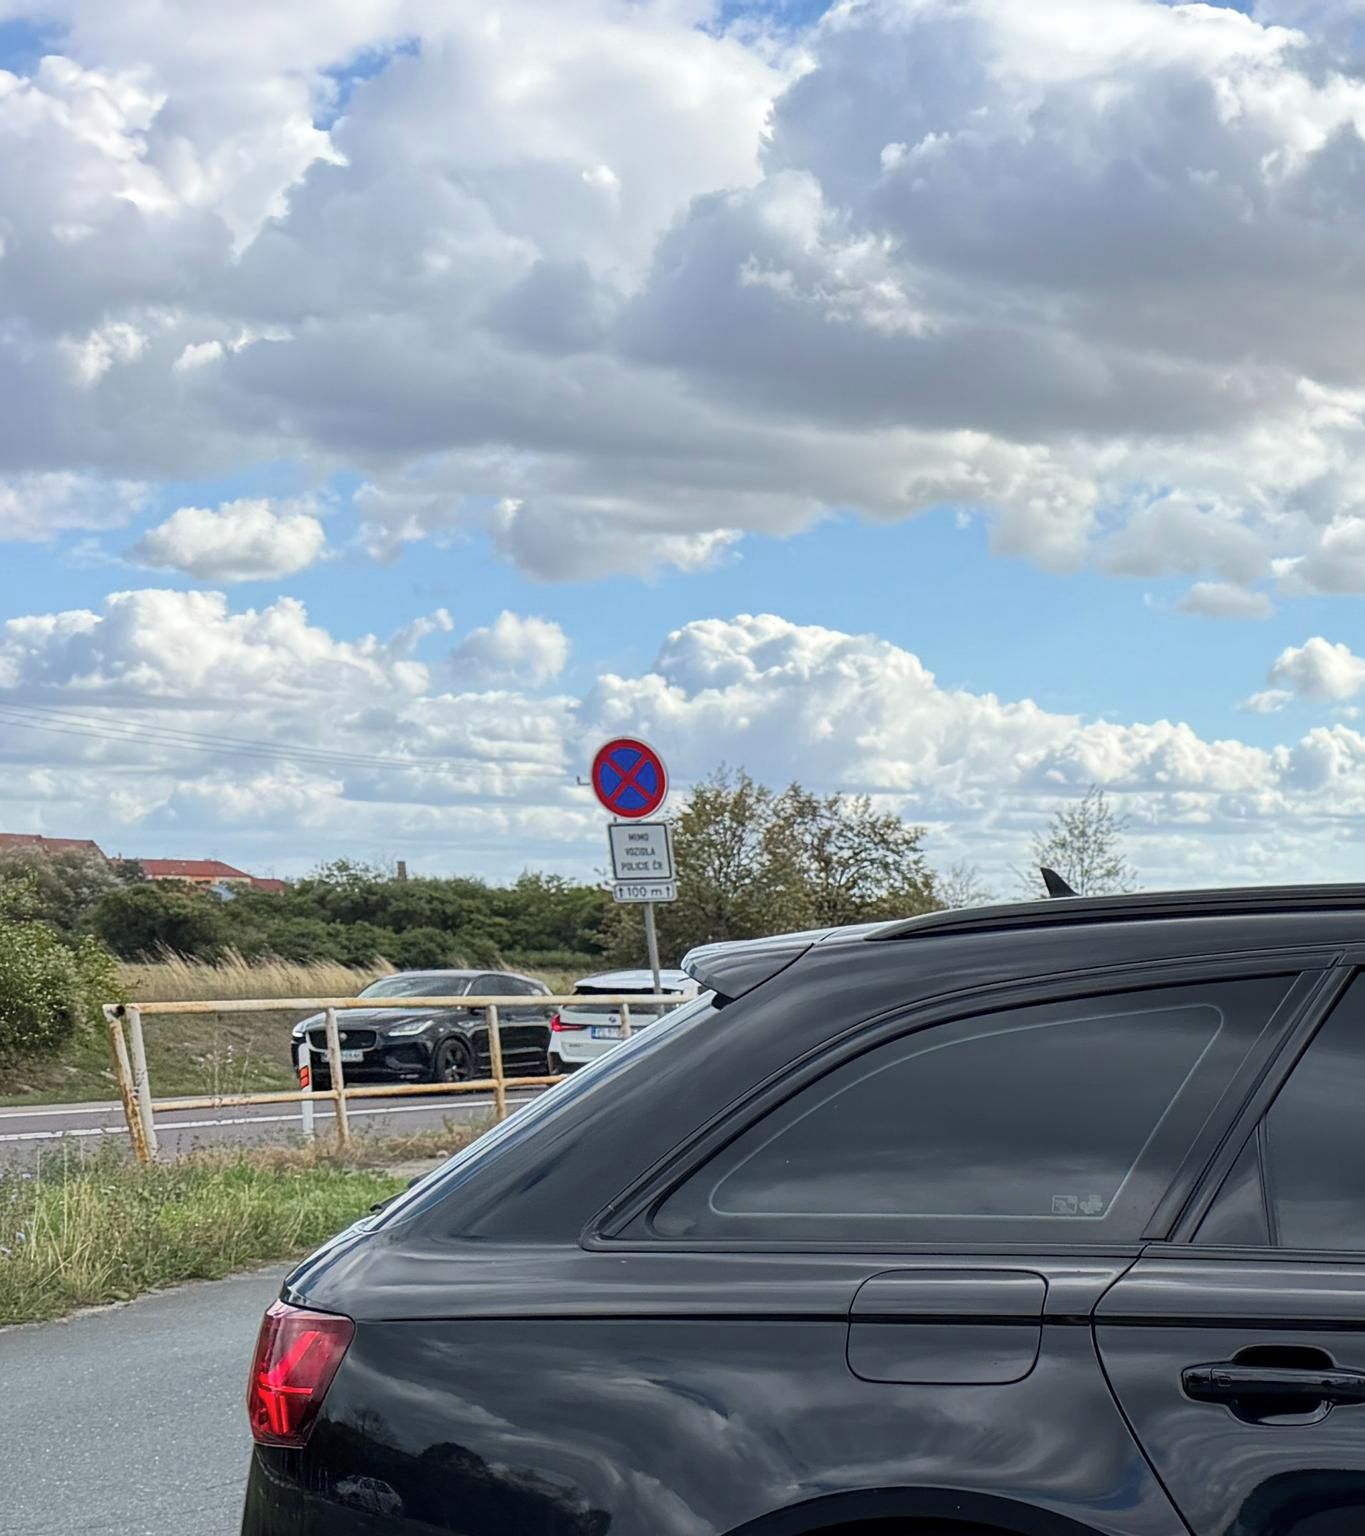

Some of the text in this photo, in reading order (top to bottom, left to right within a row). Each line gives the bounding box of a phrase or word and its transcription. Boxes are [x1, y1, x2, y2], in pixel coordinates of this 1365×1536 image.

[628, 833, 649, 841] MIMO
[625, 847, 656, 856] VOZIDLA
[627, 887, 647, 897] 100
